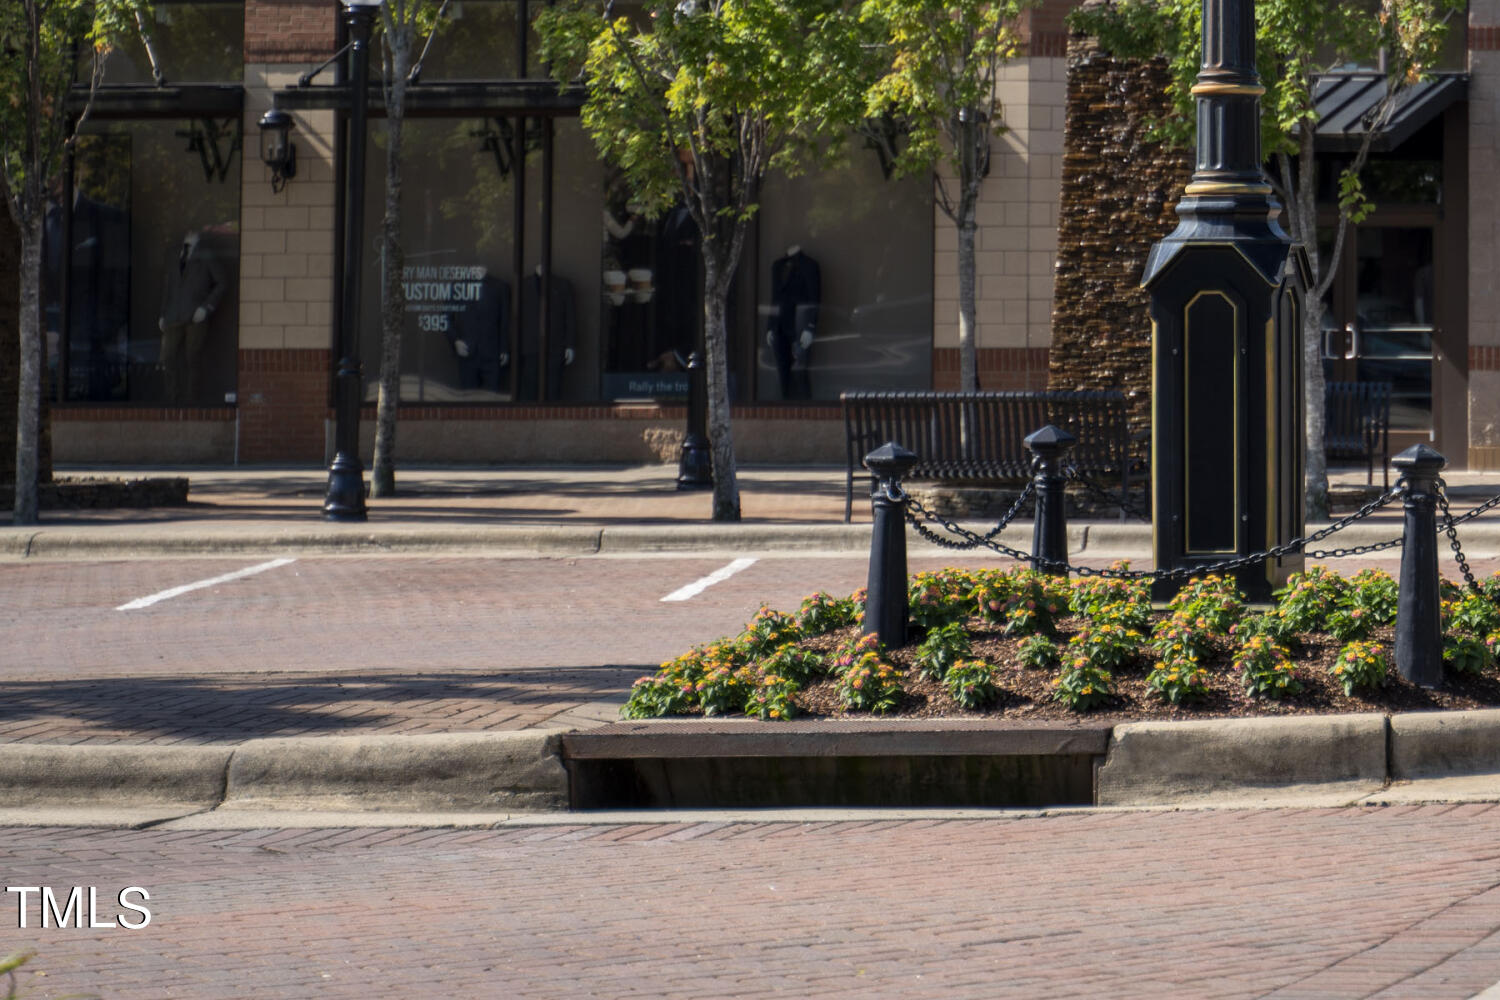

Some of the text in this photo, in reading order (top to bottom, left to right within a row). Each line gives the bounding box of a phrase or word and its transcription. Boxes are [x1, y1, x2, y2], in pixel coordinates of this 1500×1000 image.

[416, 266, 437, 280] MAN
[439, 266, 482, 280] DESERVES
[401, 282, 483, 301] USTOM SUIT
[418, 314, 449, 332] $395
[628, 381, 654, 393] Rally
[656, 381, 673, 391] the
